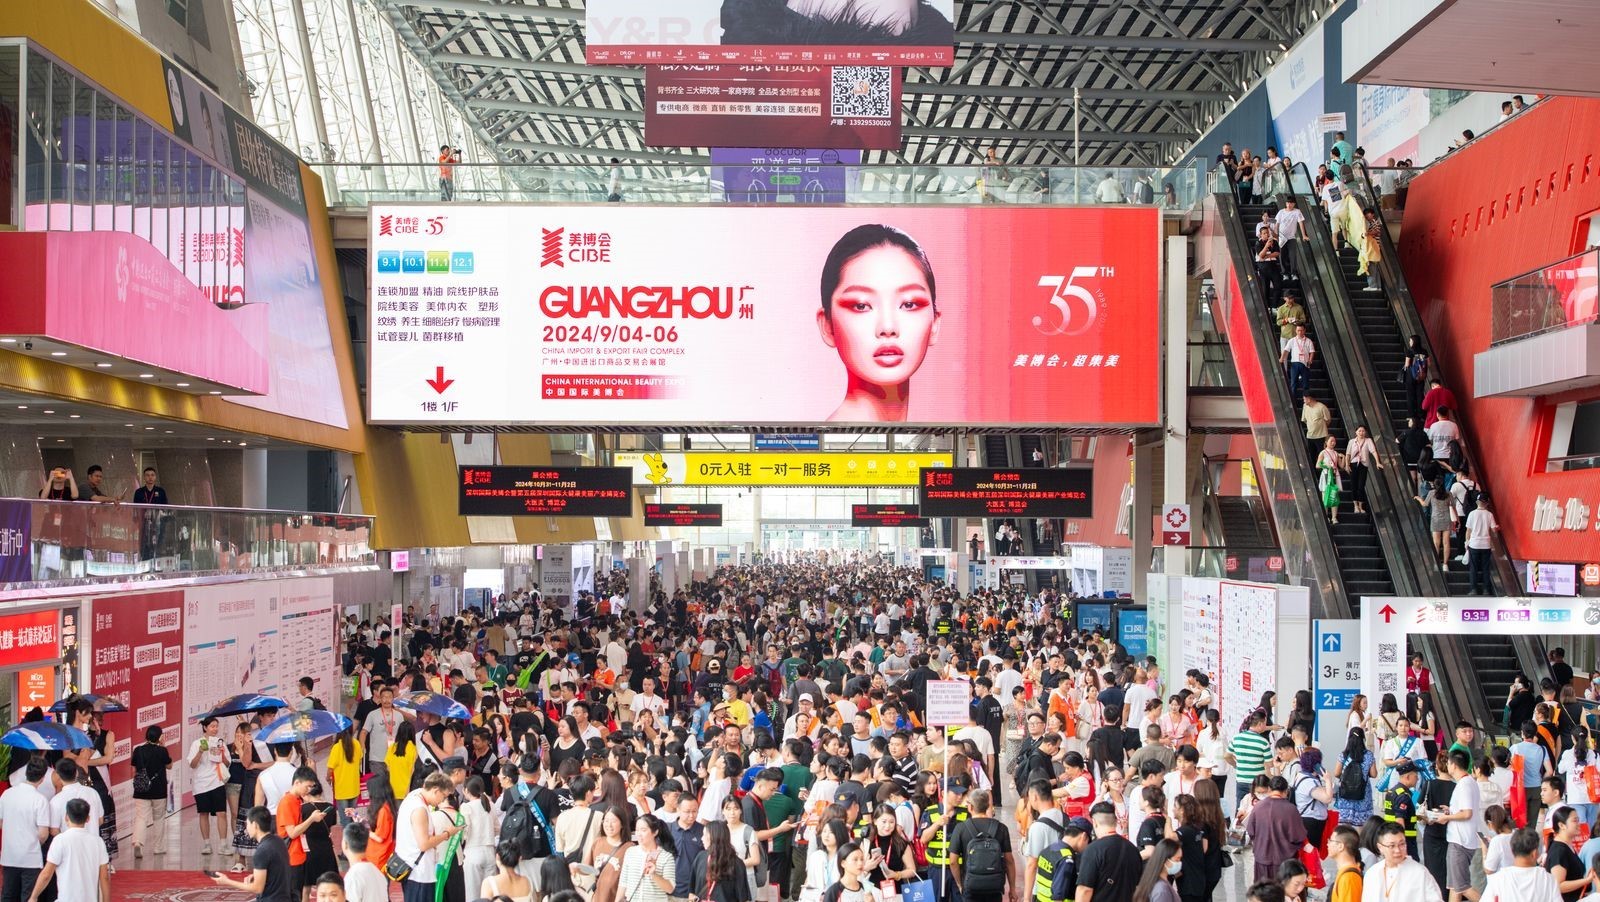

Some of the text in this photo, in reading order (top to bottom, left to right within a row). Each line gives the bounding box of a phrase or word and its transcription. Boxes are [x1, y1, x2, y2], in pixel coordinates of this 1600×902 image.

[686, 86, 720, 95] 三大研究院
[721, 86, 755, 96] 一家商学院
[758, 87, 778, 96] 全品类
[660, 103, 689, 112] 专供电商
[711, 104, 726, 113] 直销
[729, 104, 751, 113] 新零售
[755, 104, 786, 114] 美容连锁
[788, 104, 819, 114] 医美机构
[849, 119, 892, 127] 13929530020
[750, 157, 821, 173] 双逆皇后
[395, 226, 419, 234] CIBE
[569, 232, 611, 247] 美博会
[569, 248, 611, 263] CIBE
[382, 257, 397, 267] 9.1
[405, 258, 423, 267] 10.1
[430, 258, 448, 267] 11.1
[454, 258, 472, 267] 12.1
[1100, 266, 1115, 277] TH
[377, 286, 499, 297] 连锁加盟 精油 院线护肤品
[377, 301, 499, 312] 院线美容 美体内衣 塑形
[539, 285, 733, 319] GUANGZHOU
[738, 285, 754, 319] 广州
[1032, 266, 1098, 336] 35
[401, 316, 420, 327] 养生
[422, 316, 460, 327] 细胞治疗
[462, 316, 500, 327] 慢病管理
[377, 331, 464, 342] 试管婴儿 菌群移植
[542, 324, 679, 342] 2024/9/04-06
[542, 347, 685, 355] CHINA IMPORT & EXPORT FAIR COMPLEX
[545, 378, 571, 386] CHINA
[572, 378, 633, 386] INTERNATIONAL
[635, 378, 662, 386] BEAUTY
[545, 388, 624, 397] 中国国际美博会
[421, 401, 458, 412] 1楼 1/F
[700, 462, 752, 477] 0元入驻
[759, 462, 832, 477] 一对一服务
[0, 528, 23, 557] 进行中
[1463, 611, 1480, 621] 9.3
[1498, 611, 1519, 621] 10.3
[1539, 611, 1558, 621] 11.3
[1323, 665, 1340, 678] 3F
[1323, 692, 1340, 707] 2F
